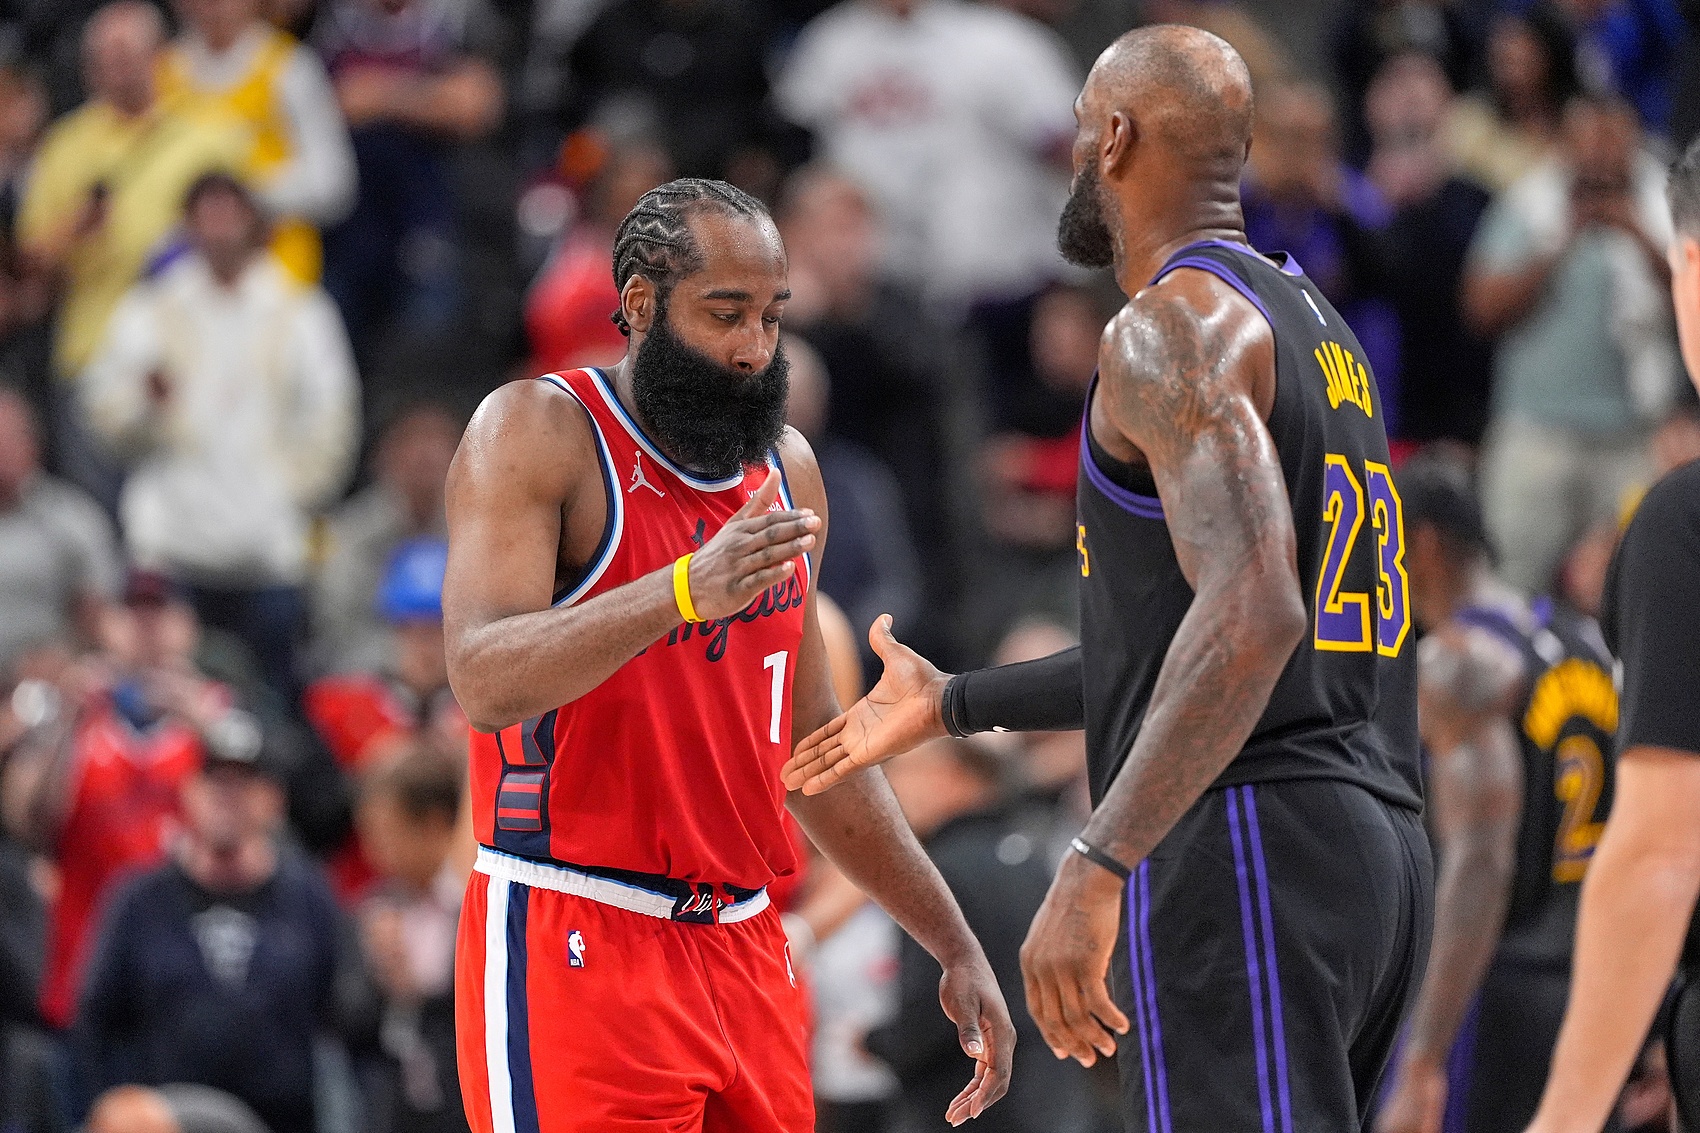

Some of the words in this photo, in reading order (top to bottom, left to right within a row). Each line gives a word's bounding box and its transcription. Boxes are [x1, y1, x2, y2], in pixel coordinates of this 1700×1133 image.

[1314, 340, 1373, 418] JAMES
[1314, 452, 1412, 659] 23
[763, 650, 789, 744] 1
